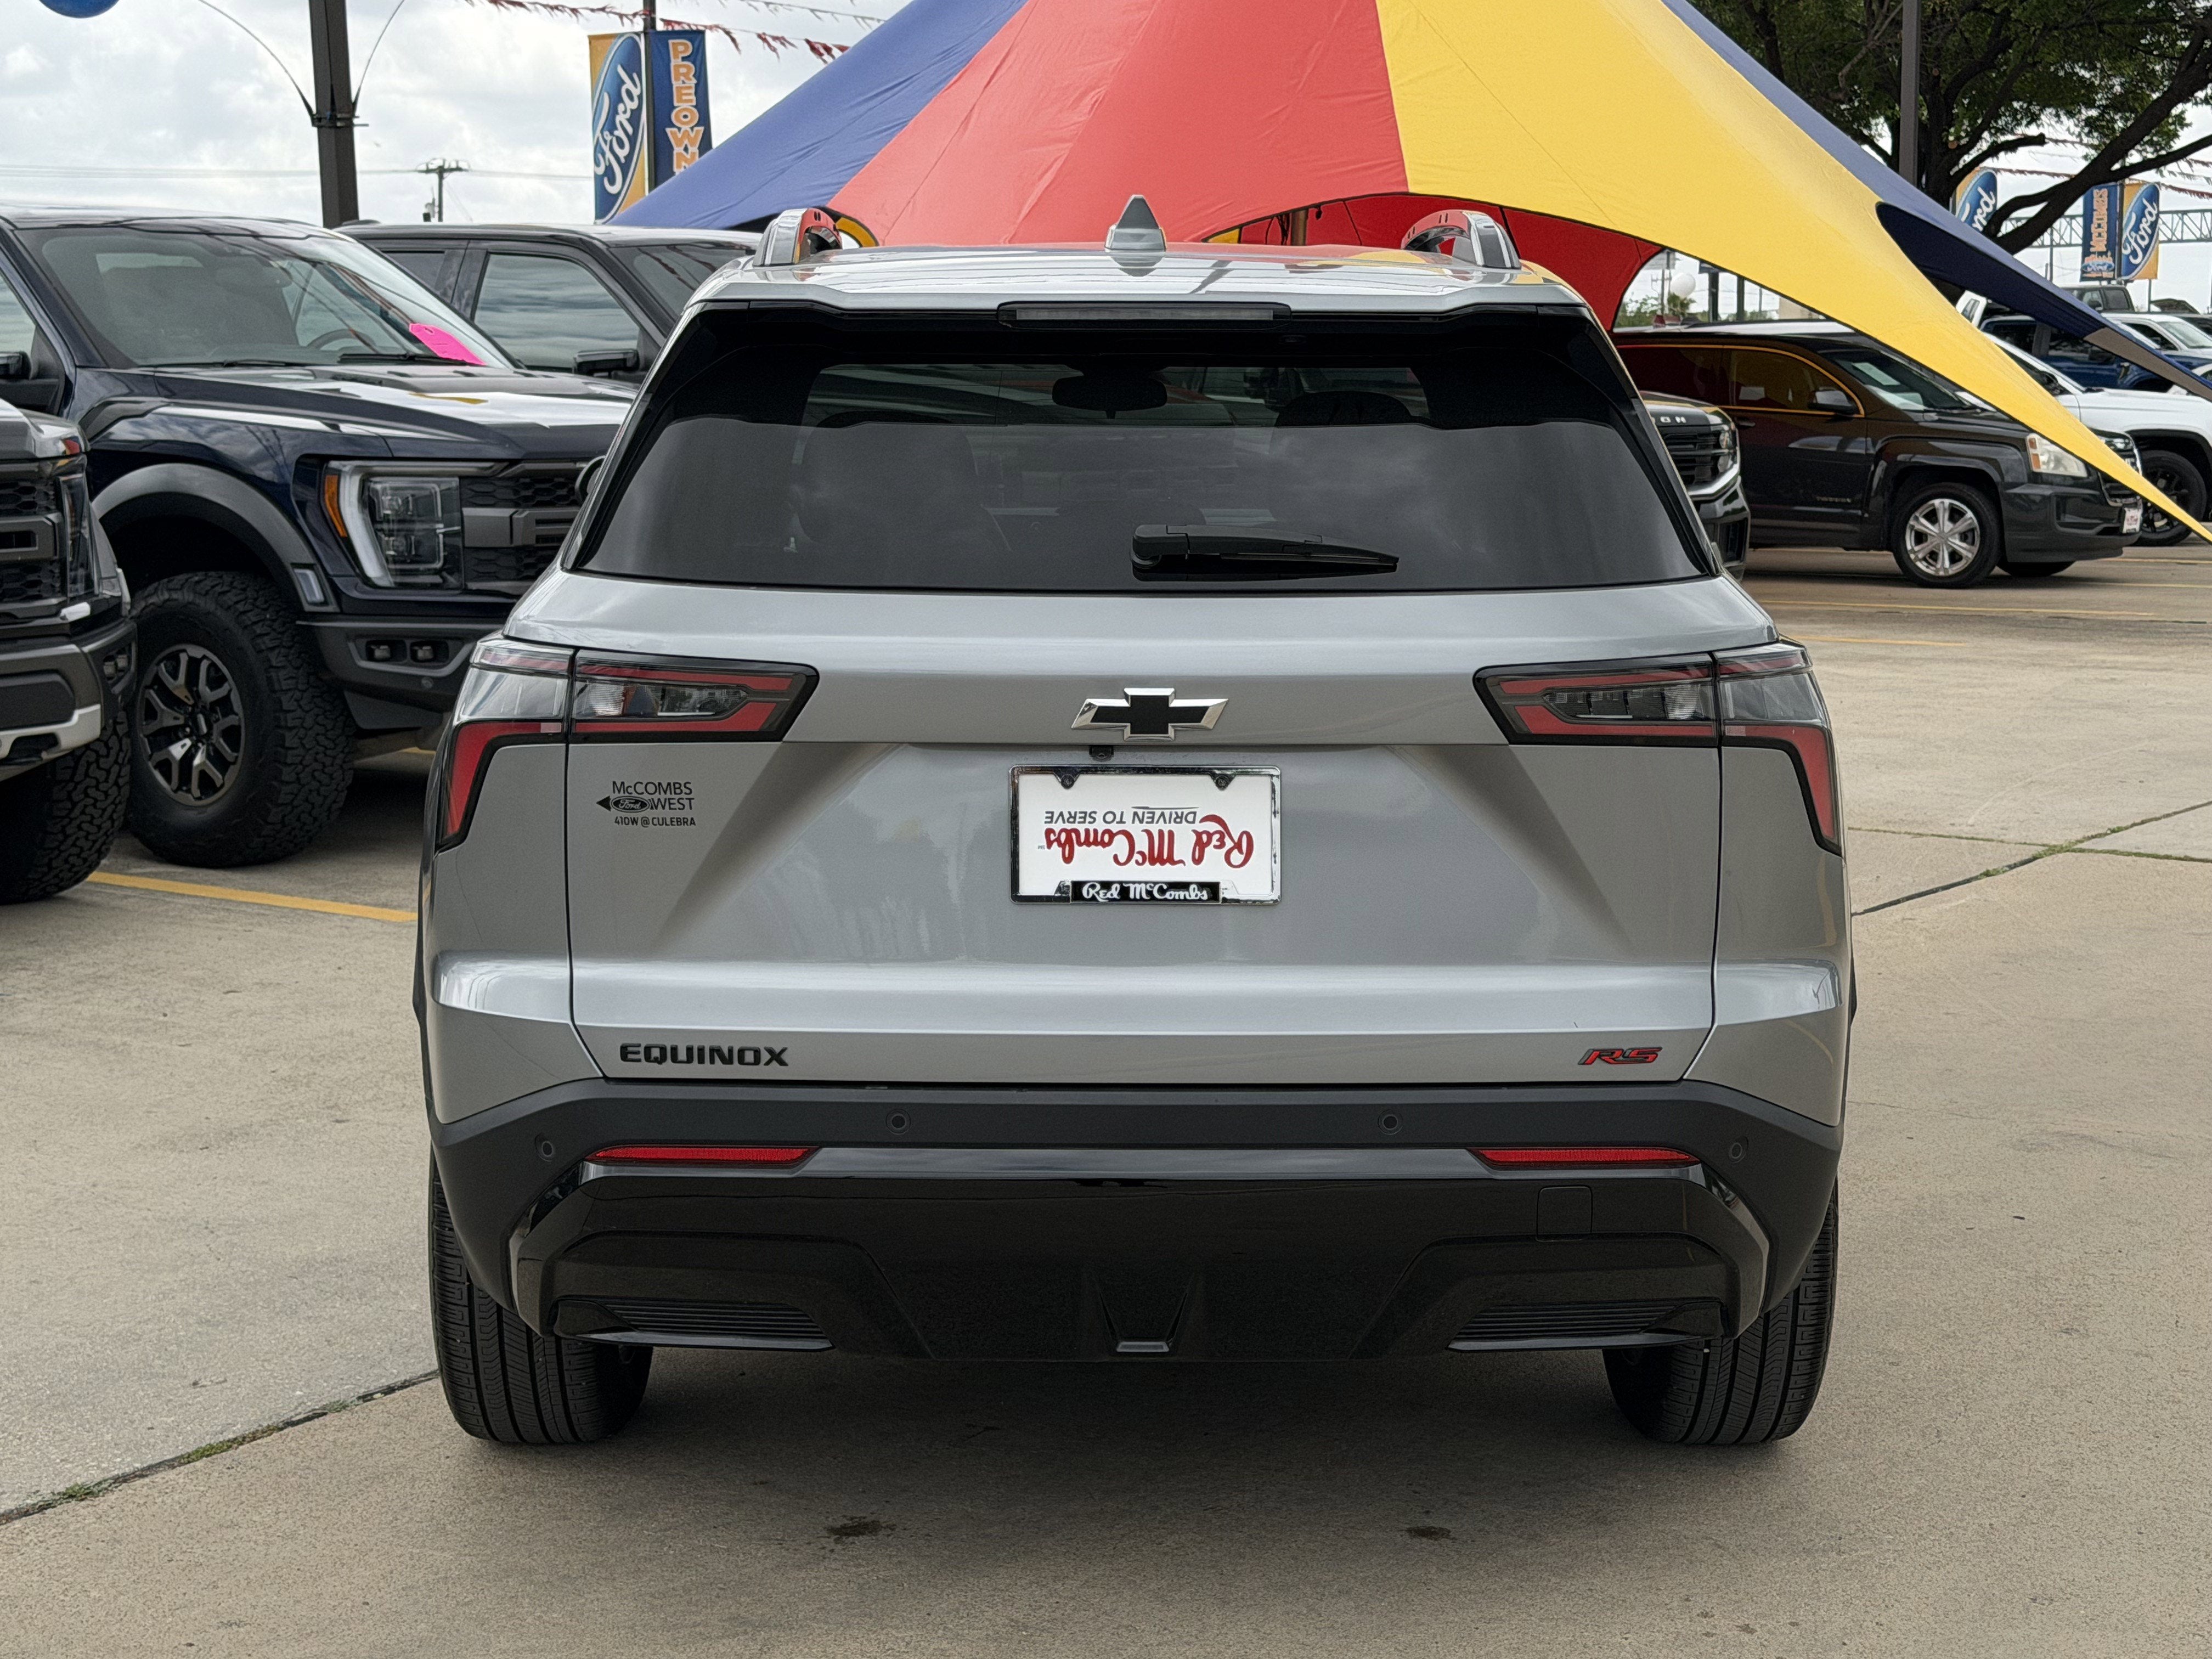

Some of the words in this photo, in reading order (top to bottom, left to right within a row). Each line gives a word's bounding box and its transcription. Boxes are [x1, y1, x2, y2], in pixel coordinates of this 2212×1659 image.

[594, 64, 641, 195] Ford
[2121, 198, 2158, 264] Ford
[612, 781, 692, 795] McCOMBS
[618, 799, 641, 810] Ford
[651, 798, 695, 810] WEST
[651, 817, 696, 826] CULEBRA
[1044, 811, 1097, 824] SERVE
[1103, 811, 1126, 824] TO
[1132, 811, 1197, 824] DRIVEN
[1045, 828, 1186, 867] McCombs
[1192, 814, 1254, 868] Red
[1082, 882, 1120, 902] Red
[1123, 883, 1208, 900] McCombs
[620, 1043, 788, 1066] EQUINOX
[1578, 1047, 1663, 1065] RS
